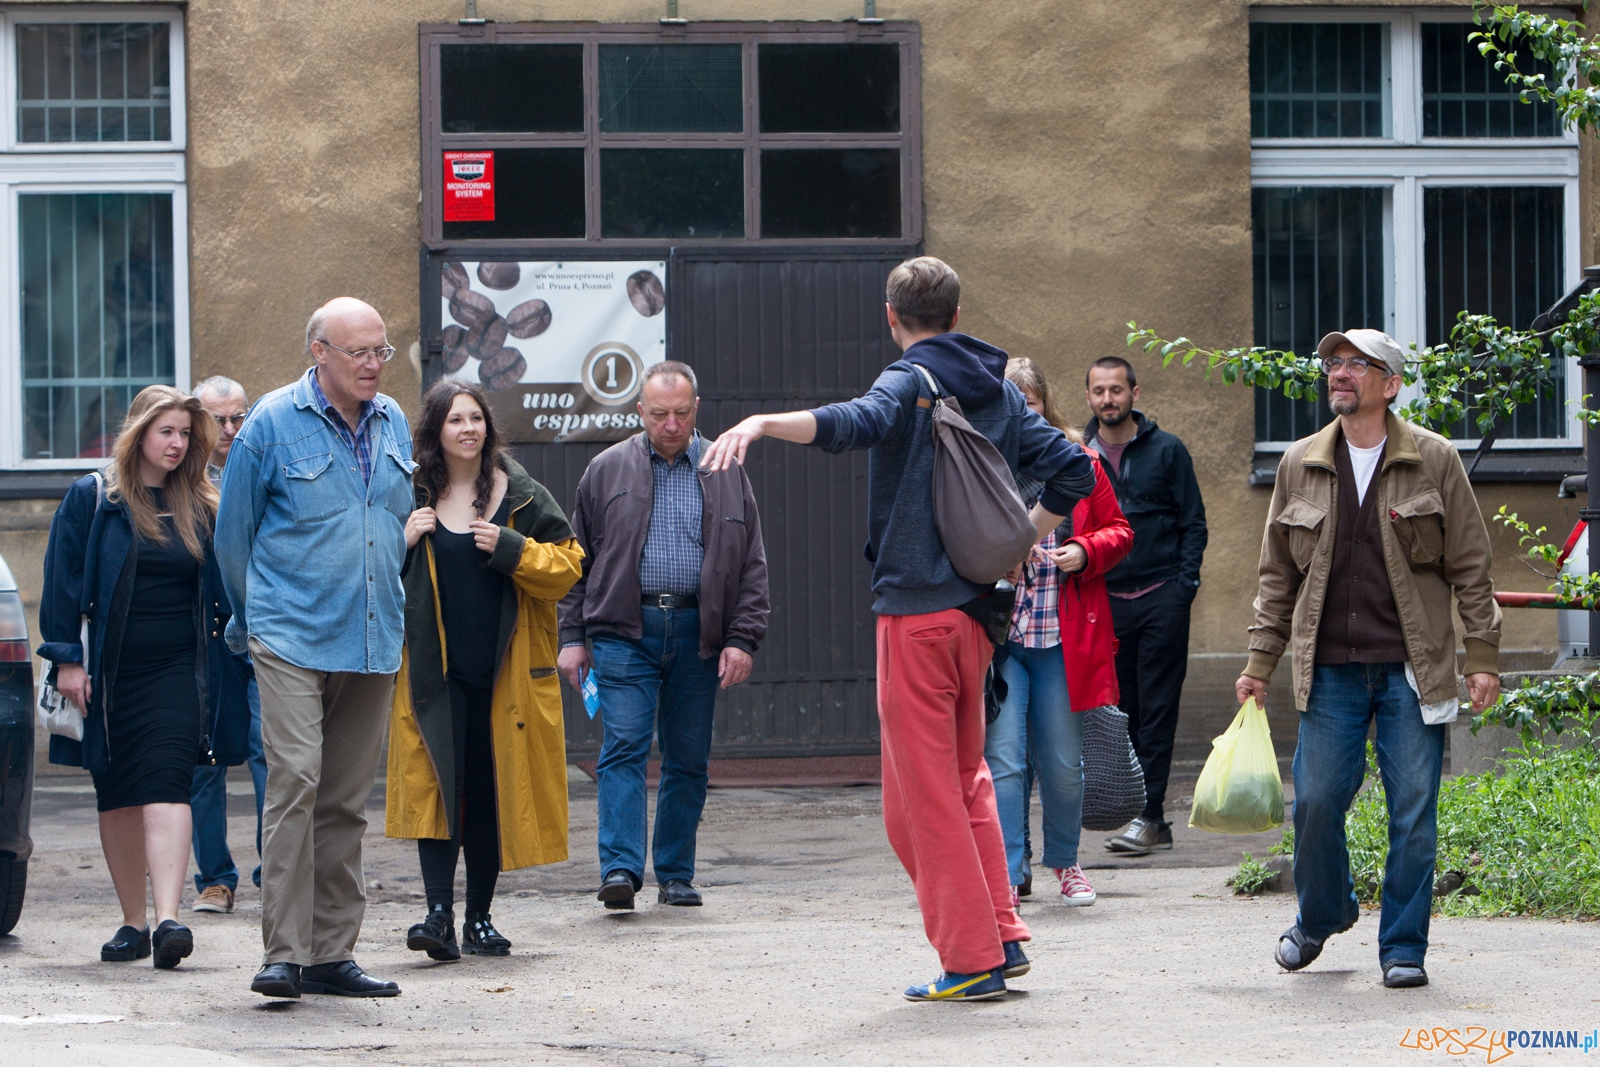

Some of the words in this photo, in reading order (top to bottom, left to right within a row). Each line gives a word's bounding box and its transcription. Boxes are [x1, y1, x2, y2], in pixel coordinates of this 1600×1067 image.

[447, 182, 491, 190] MONITORING
[455, 190, 483, 198] SYSTEM
[535, 272, 614, 281] www.unoespresso.pl
[582, 282, 612, 290] Poznań
[606, 356, 618, 388] 1
[523, 392, 575, 409] uno
